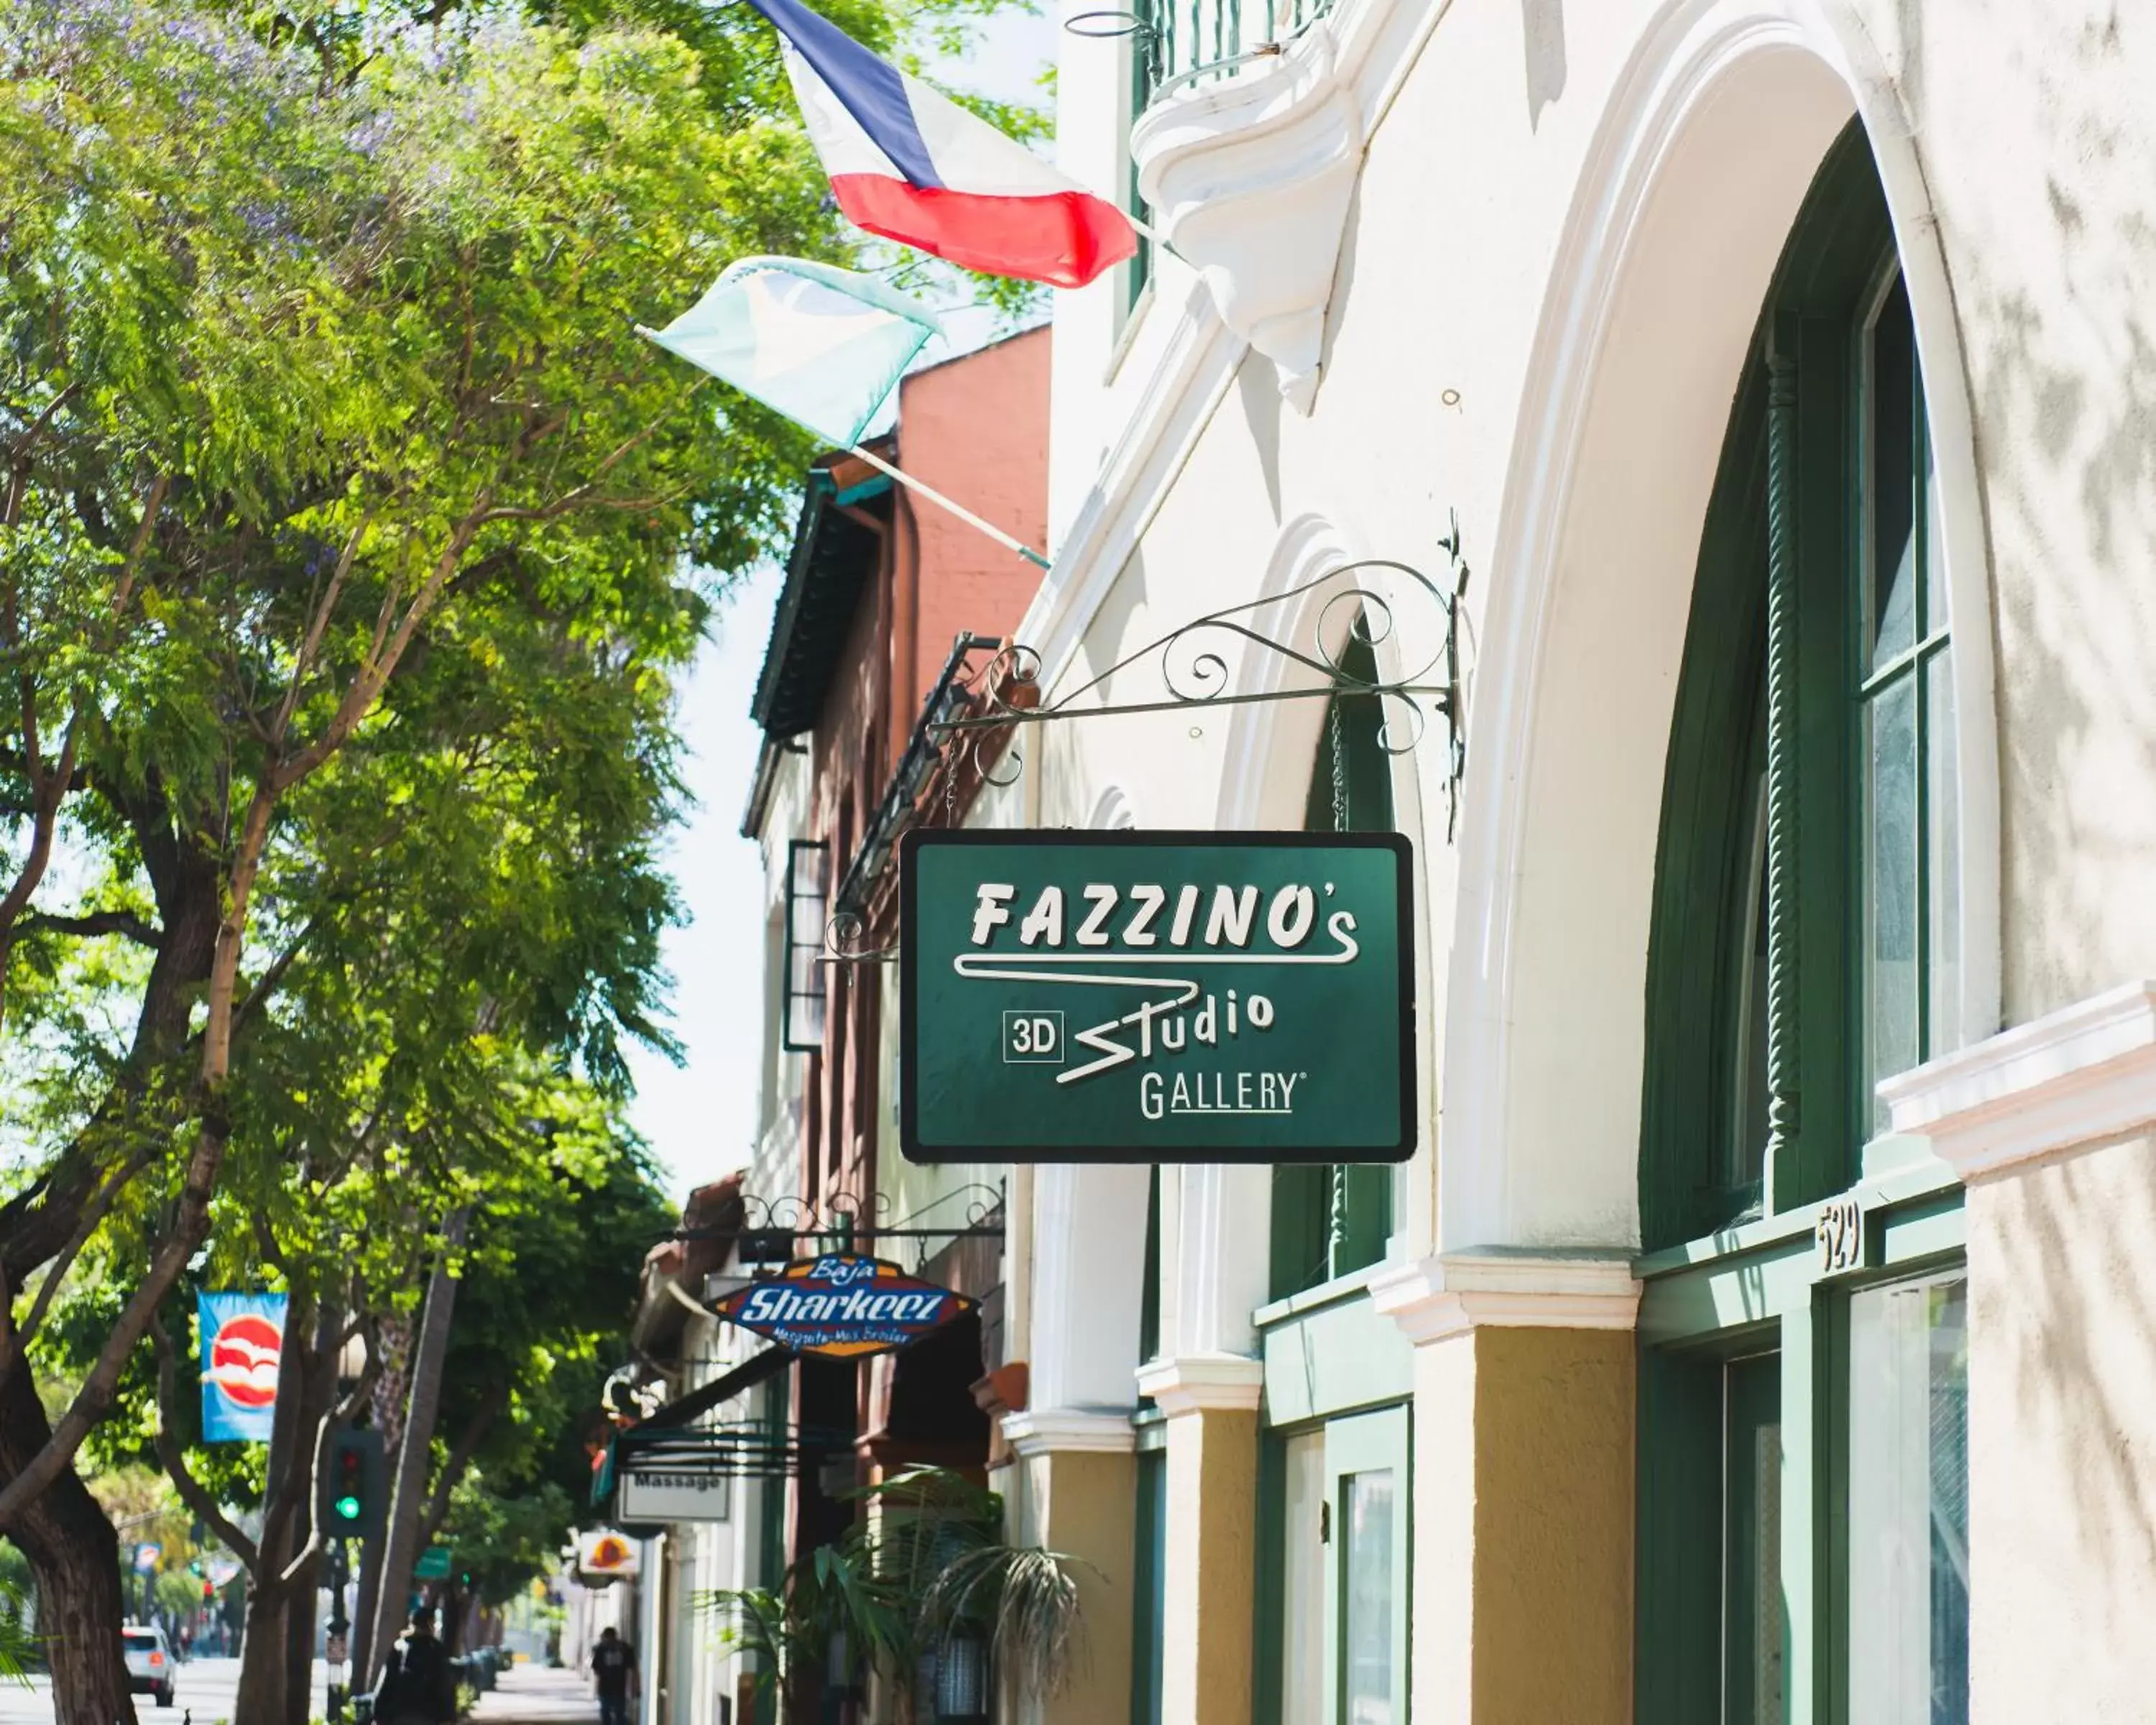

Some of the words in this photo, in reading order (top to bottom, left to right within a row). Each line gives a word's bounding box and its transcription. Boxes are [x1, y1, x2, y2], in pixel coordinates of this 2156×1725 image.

[971, 883, 1360, 965] FAZZINO's
[1012, 1017, 1056, 1054] 3D
[1055, 985, 1276, 1085] Studio
[1818, 1201, 1860, 1272] 529
[811, 1259, 875, 1286] Baja
[742, 1288, 943, 1321] Sharkeez
[634, 1473, 720, 1493] Massage
